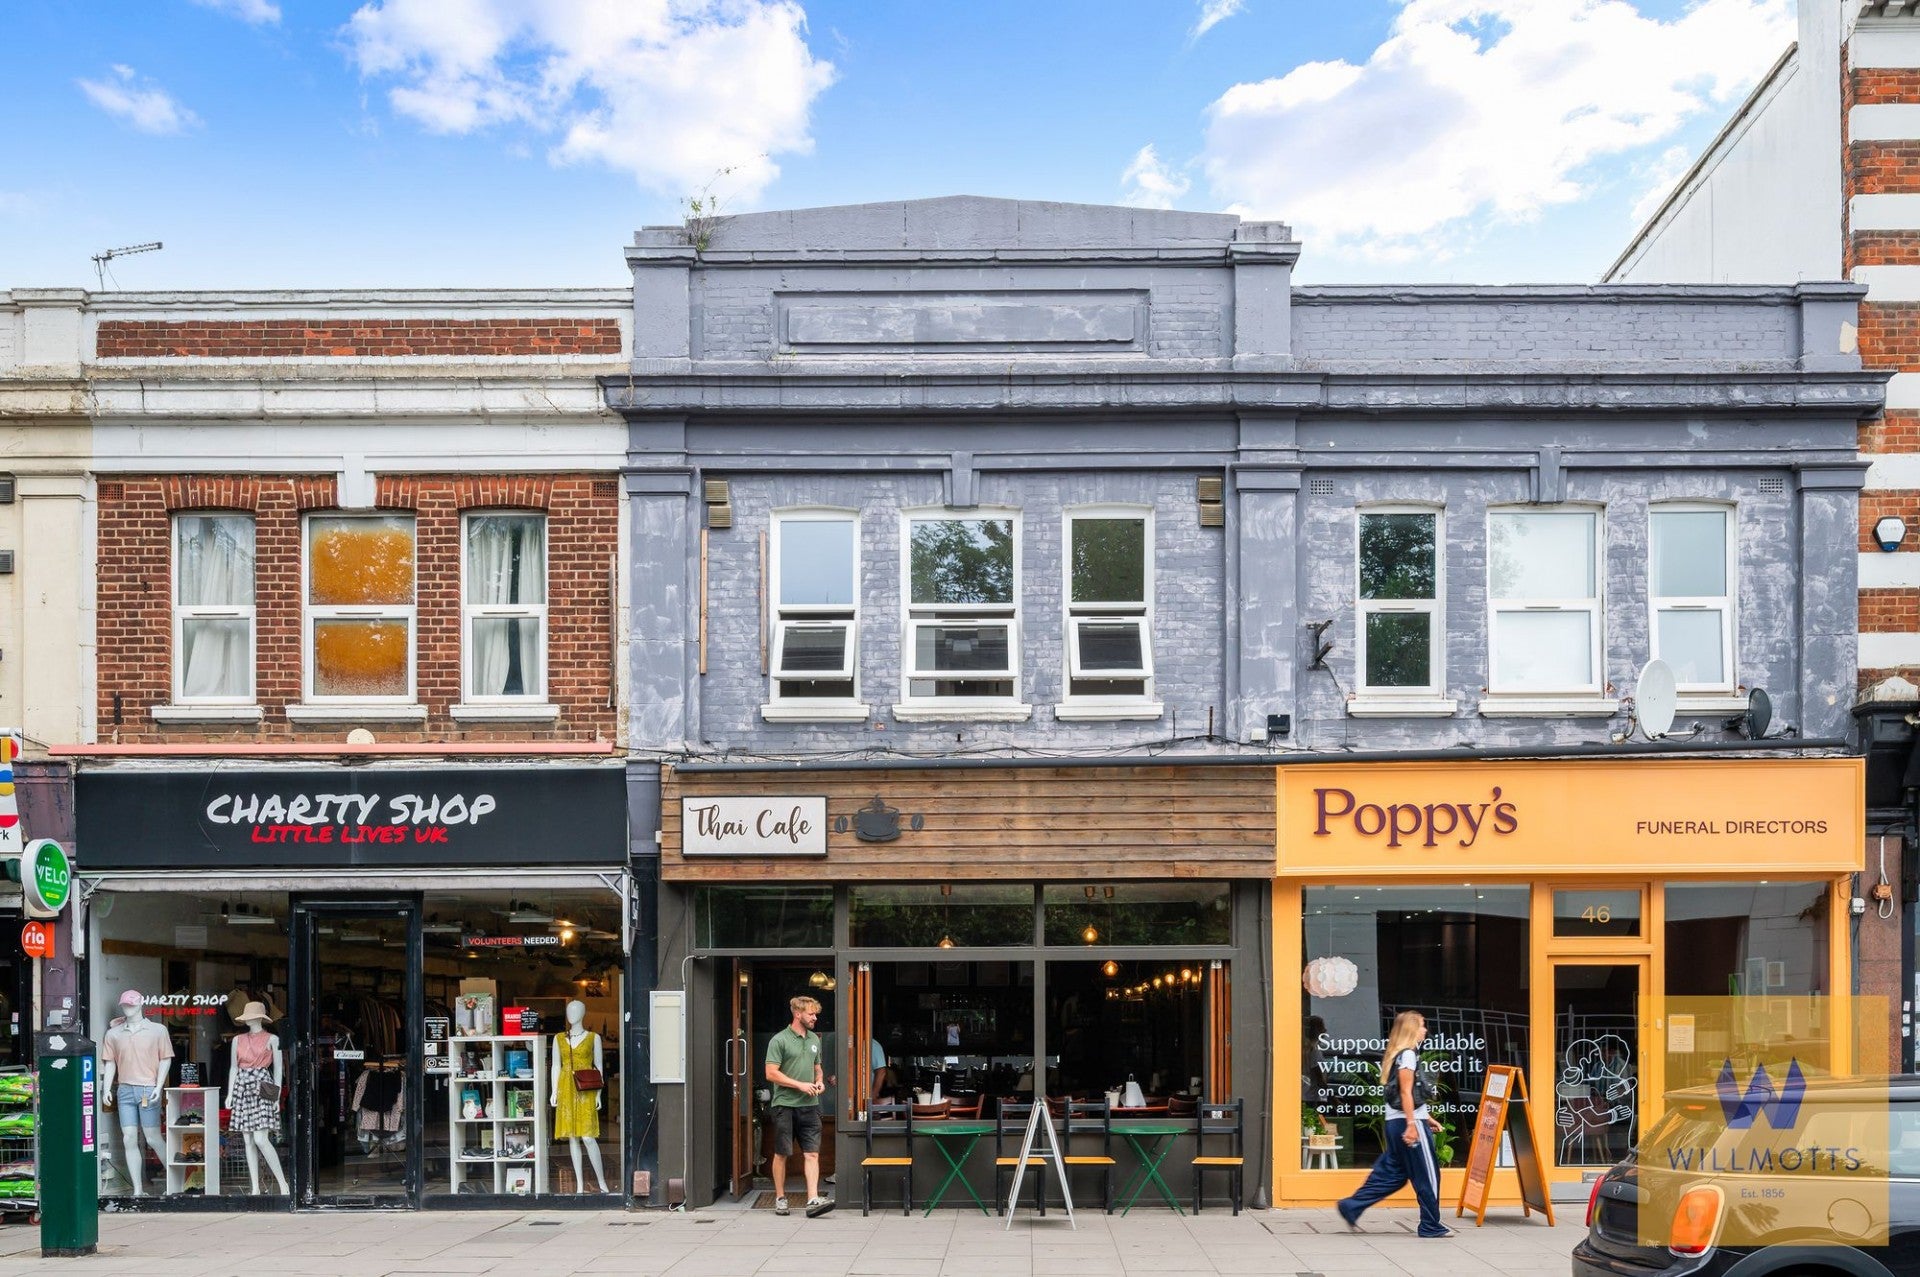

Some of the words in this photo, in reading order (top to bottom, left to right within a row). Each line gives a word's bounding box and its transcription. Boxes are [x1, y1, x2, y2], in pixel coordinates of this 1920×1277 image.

[207, 793, 380, 825] CHARITY
[389, 793, 497, 825] SHOP
[1313, 785, 1519, 848] Poppy's
[688, 804, 749, 841] Thai
[756, 805, 813, 844] Cafe
[1636, 821, 1721, 835] FUNERAL
[1725, 820, 1828, 834] DIRECTORS
[251, 825, 333, 843] LITTLE
[340, 825, 410, 843] LIVES
[414, 826, 448, 843] UK
[1581, 905, 1611, 923] 46
[25, 925, 45, 945] ria
[468, 936, 522, 945] VOLUNTEERS
[523, 936, 559, 945] NEEDED!
[141, 994, 190, 1006] HARITY
[192, 994, 229, 1006] SHOP
[1317, 1032, 1390, 1055] Suppor
[1415, 1032, 1485, 1051] vailable
[1317, 1055, 1370, 1073] when
[1469, 1056, 1484, 1073] it
[1317, 1088, 1335, 1097] on
[1338, 1085, 1365, 1097] 020
[1317, 1104, 1333, 1114] or
[1336, 1102, 1351, 1113] at
